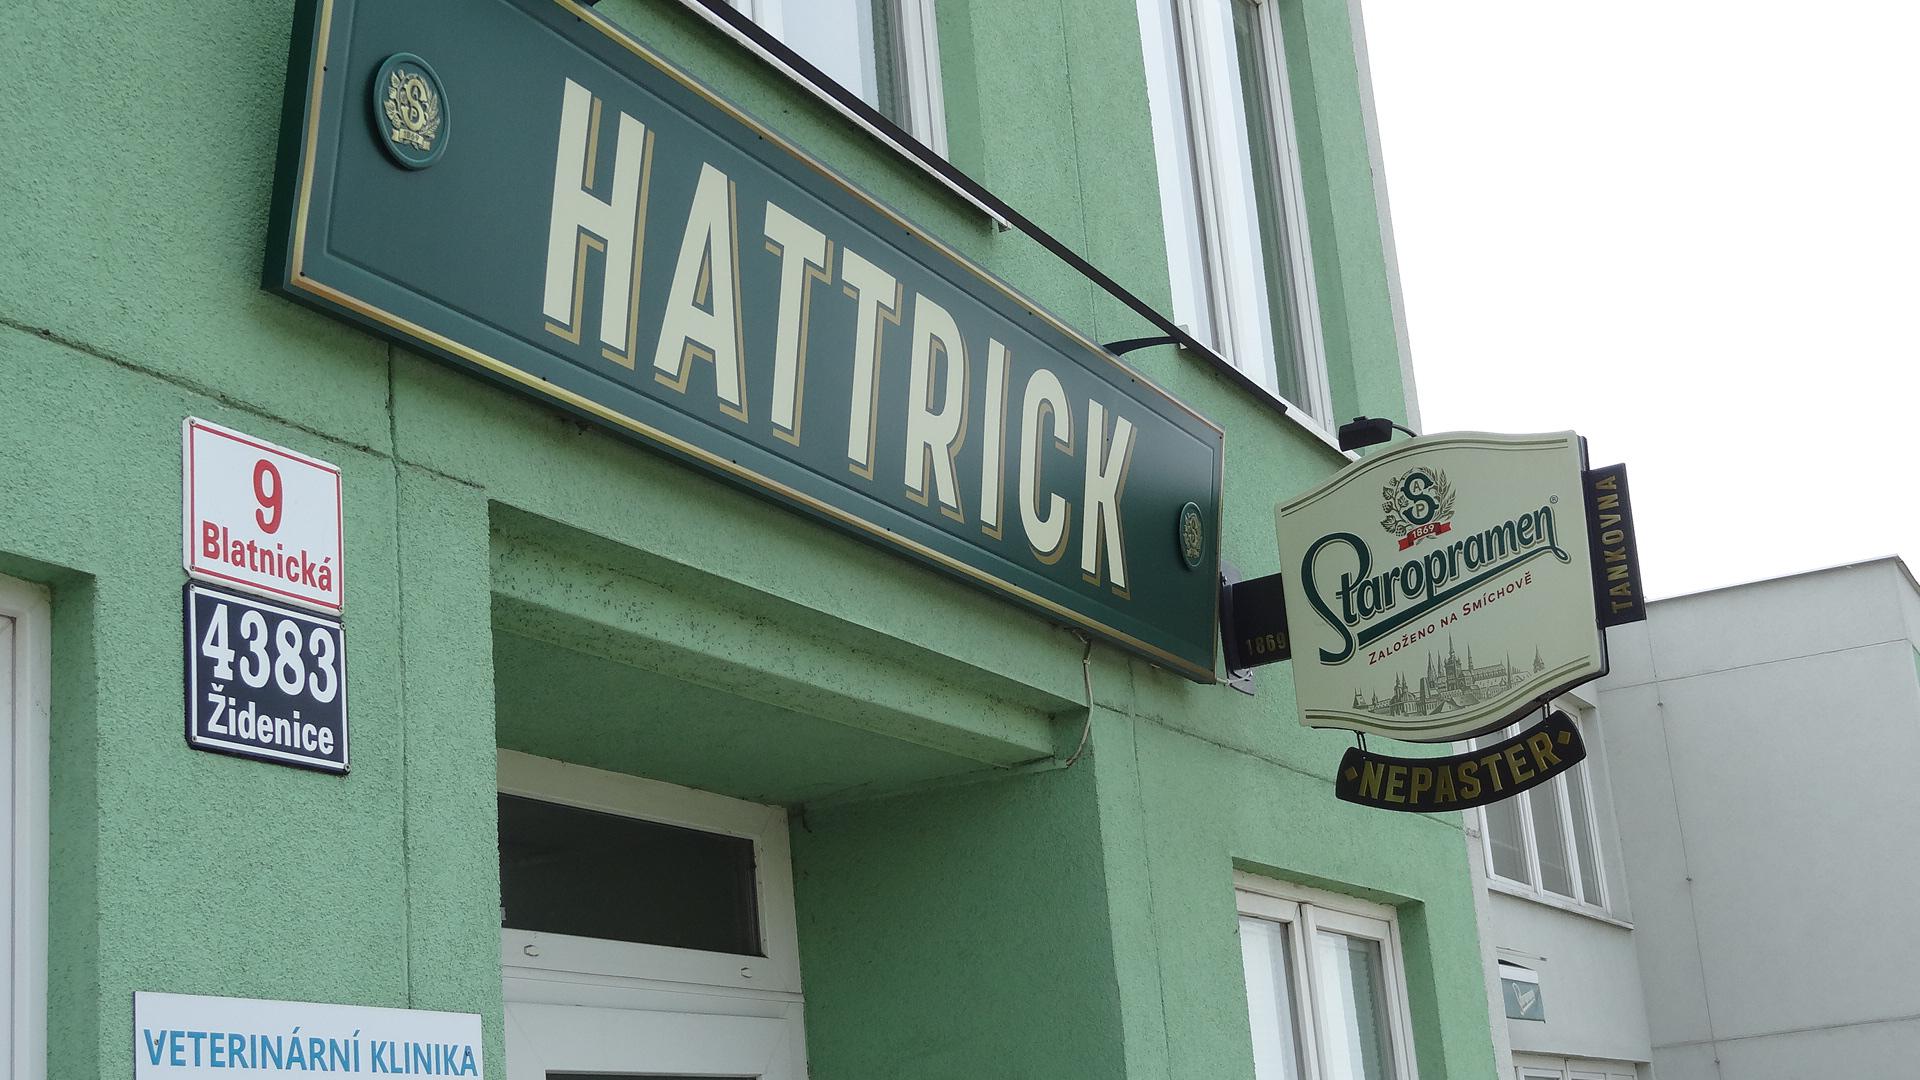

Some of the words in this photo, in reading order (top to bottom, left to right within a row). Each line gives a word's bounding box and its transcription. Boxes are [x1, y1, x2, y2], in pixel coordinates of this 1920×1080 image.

[543, 77, 1136, 600] HATTRICK
[253, 459, 283, 534] 9
[1412, 525, 1435, 539] 1869
[202, 520, 333, 593] Blatnická
[1595, 475, 1632, 613] TANKOVNA
[1301, 503, 1571, 665] Staropramen
[1368, 624, 1435, 665] ZALOŽENO
[1440, 613, 1458, 628] NA
[1462, 571, 1533, 616] SMÍCHOVĚ
[202, 603, 337, 703] 4383
[1246, 632, 1287, 656] 1869
[208, 682, 335, 755] Židenice
[1358, 731, 1563, 804] NEPASTER
[143, 1026, 361, 1073] VETERINÁRNÍ
[370, 1040, 479, 1077] KLINIKA
